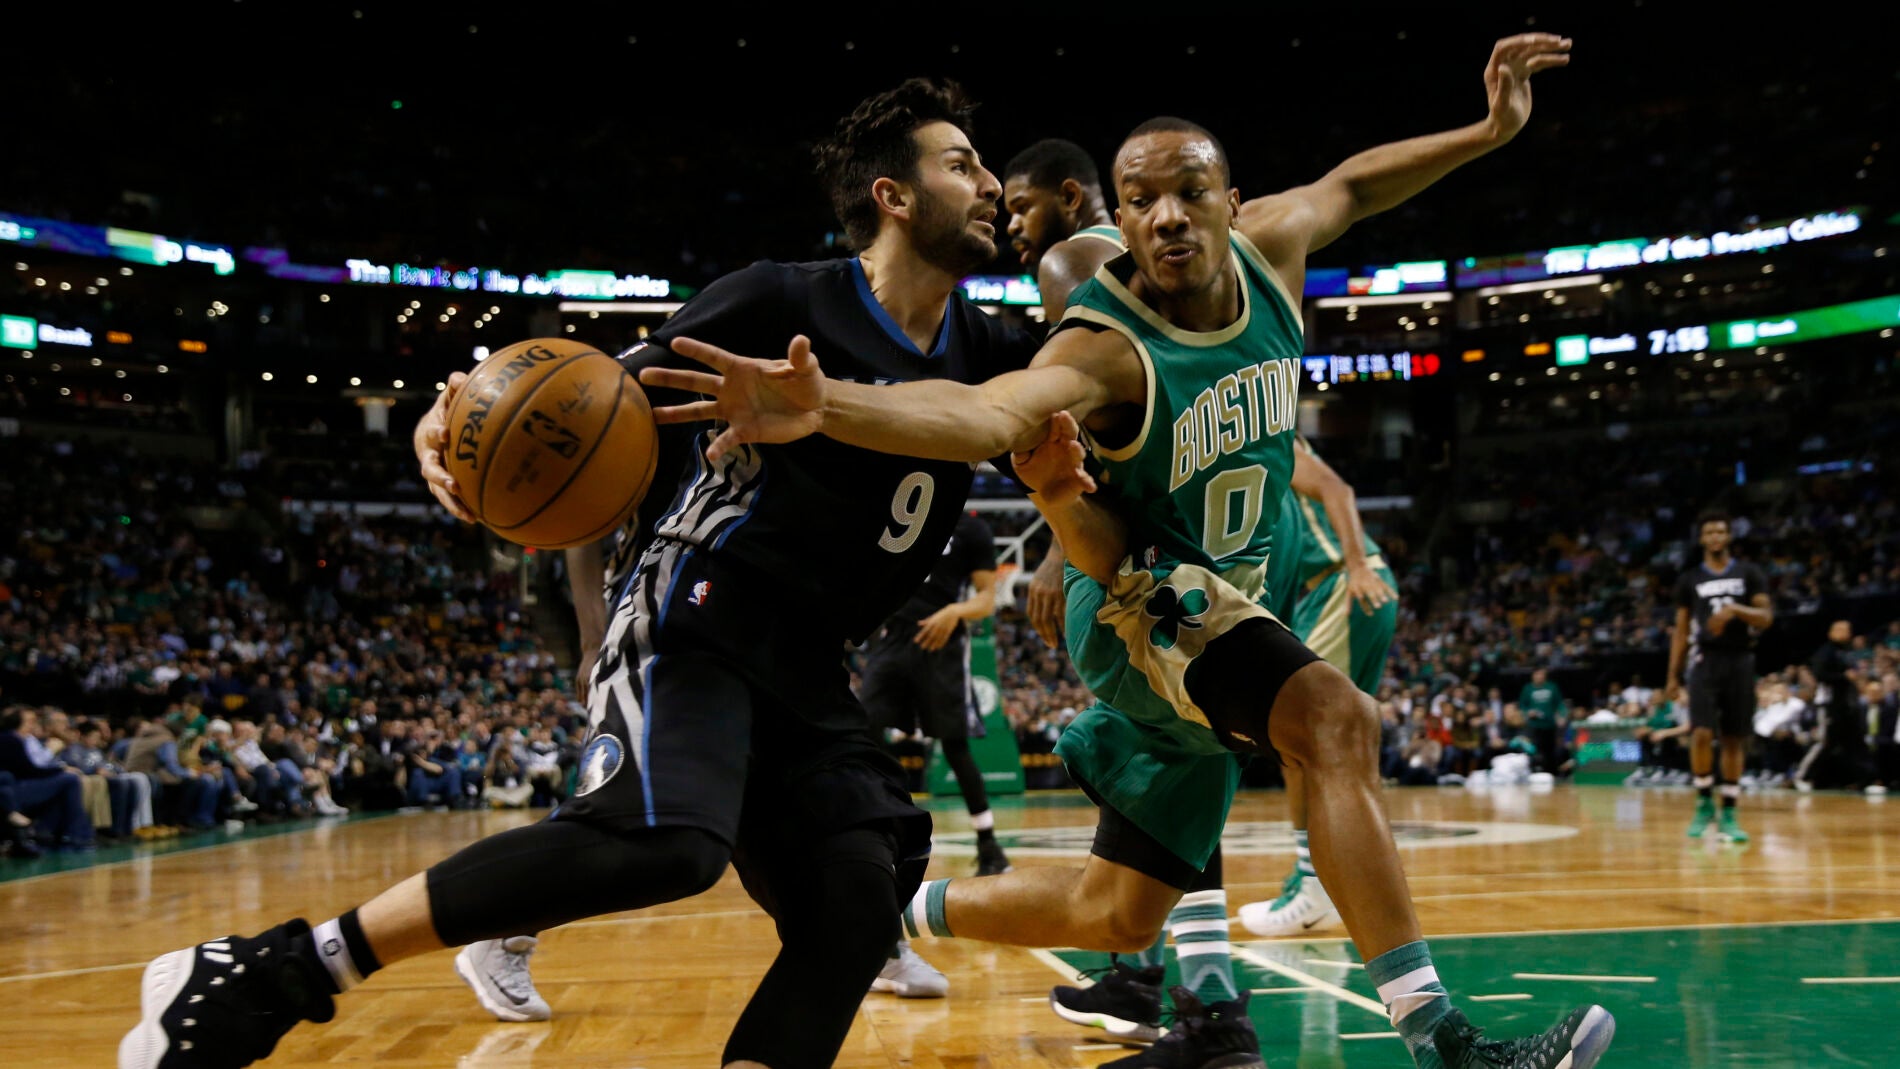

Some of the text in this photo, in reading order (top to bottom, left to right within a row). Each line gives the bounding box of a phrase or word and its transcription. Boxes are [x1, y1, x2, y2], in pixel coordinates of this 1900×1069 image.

[346, 259, 390, 284] The
[452, 267, 478, 290] of
[456, 345, 559, 471] SPALDING
[1169, 357, 1300, 494] BOSTON
[877, 471, 935, 554] 9
[1202, 463, 1268, 561] 0
